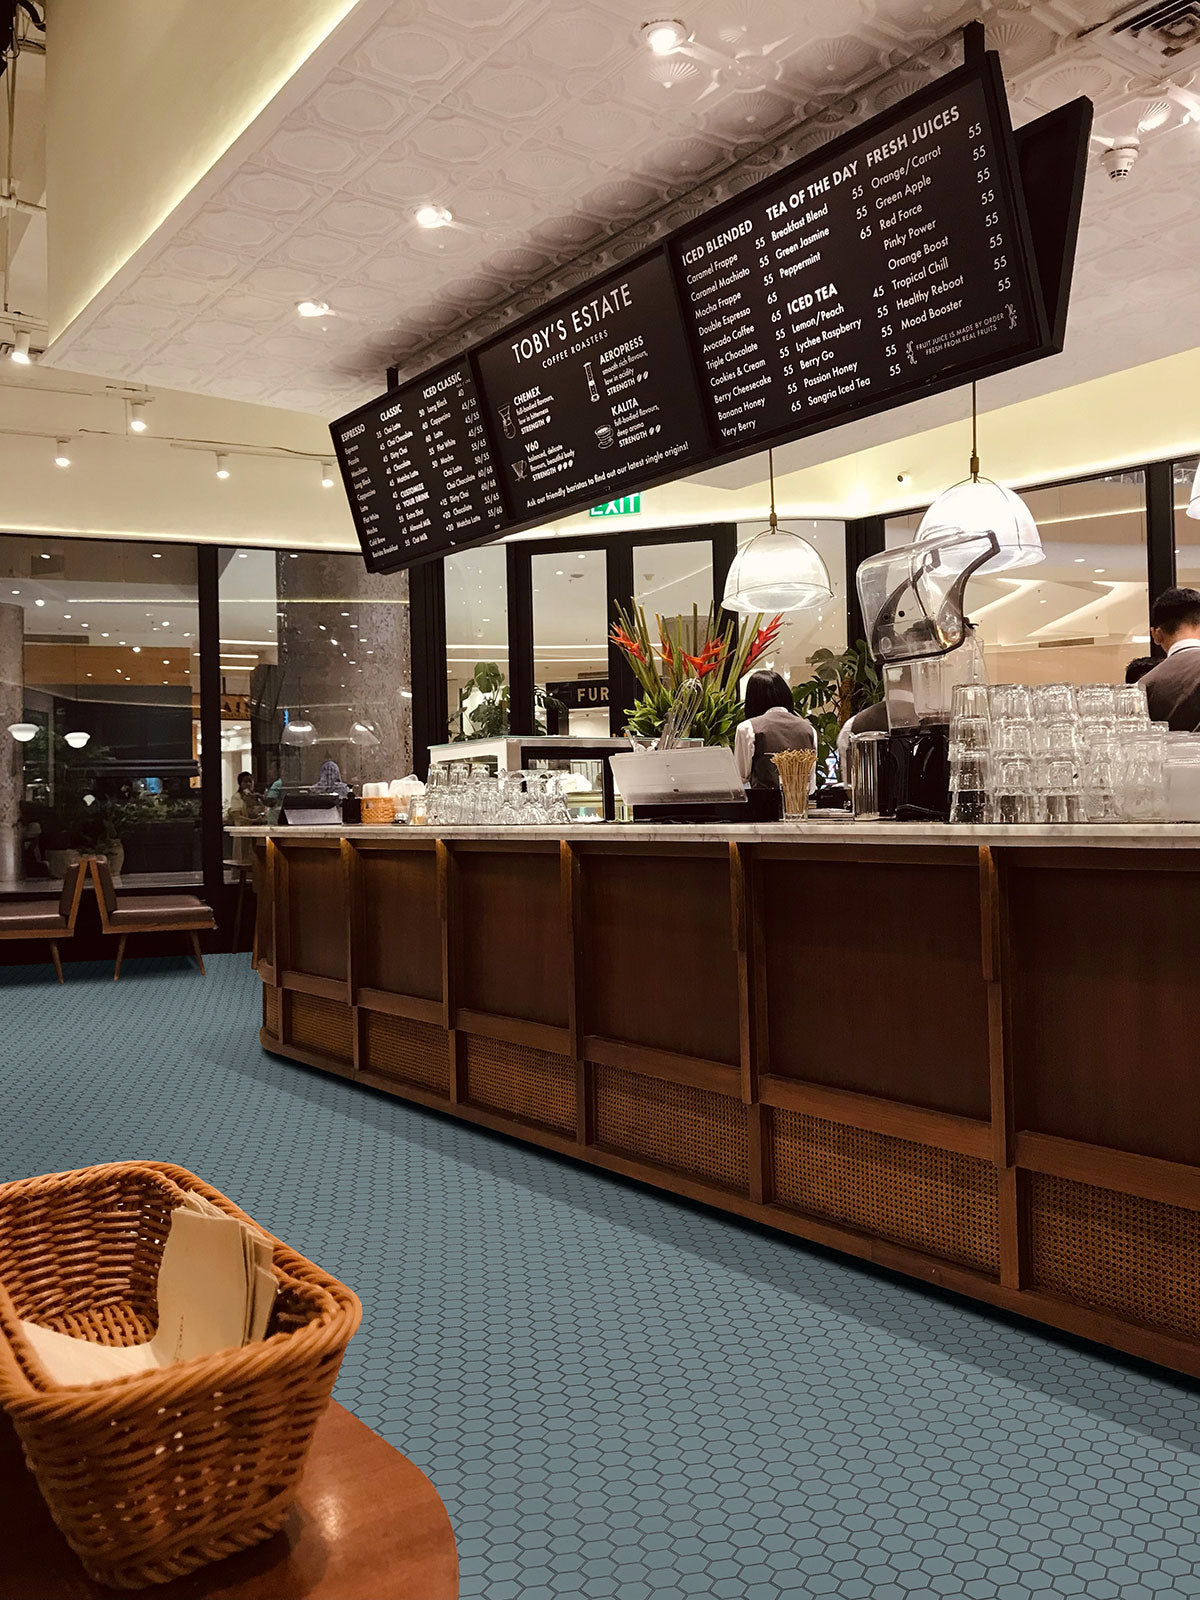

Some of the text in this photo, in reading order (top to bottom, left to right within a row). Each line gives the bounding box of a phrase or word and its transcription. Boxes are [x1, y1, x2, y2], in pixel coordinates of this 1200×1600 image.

[867, 106, 959, 167] FRESH JUICES
[871, 123, 981, 188] Orange/Carrot 55
[766, 160, 857, 220] TEA OF THE DAY
[876, 145, 986, 209] Green Apple 55
[880, 167, 990, 230] Red Force 55
[771, 185, 863, 241] Breakfast Blend 55
[776, 205, 867, 259] Green Jasmine 55
[884, 190, 994, 250] Pinky Power 55
[682, 220, 752, 266] ICED BLENDED
[687, 237, 765, 284] Caramel Frappe 55
[780, 226, 871, 278] Peppermint 65
[888, 212, 998, 269] Orange Boost 55
[891, 234, 1002, 290] Tropical Chill 55
[691, 255, 769, 301] Caramel Machiato 55
[695, 273, 773, 319] Mocha Frappe 55
[787, 283, 838, 315] ICED TEA
[896, 255, 1006, 310] Healthy Reboot 55
[512, 284, 632, 363] TOBY'S ESTATE
[699, 292, 777, 336] Double Espresso 65
[792, 285, 884, 333] Lemon/Peach 45
[901, 277, 1011, 330] Mood Booster 55
[542, 330, 608, 368] COFFEE ROASTERS
[600, 336, 643, 365] AEROPRESS
[703, 310, 781, 353] Avocado Coffee 65
[706, 328, 785, 369] Triple Chocolate 55
[796, 305, 888, 353] Lychee Raspberry 55
[800, 325, 892, 369] Berry Go 55
[916, 340, 931, 350] FRUIT
[933, 334, 948, 345] JUICE
[957, 324, 973, 335] MADE
[984, 313, 1004, 325] ORDER
[926, 345, 943, 355] FRESH
[944, 338, 961, 348] FROM
[977, 324, 997, 336] FRUITS
[423, 386, 437, 399] ICED
[437, 372, 462, 391] CLASSIC
[607, 378, 635, 396] STRENGTH
[710, 372, 736, 386] Cookies
[743, 360, 766, 373] Cream
[780, 346, 789, 358] 55
[714, 364, 793, 404] Berry Cheesecake 55
[804, 344, 896, 387] Passion Honey 55
[808, 364, 901, 405] Sangria Iced Tea 55
[380, 404, 402, 421] CLASSIC
[514, 386, 541, 406] CHEMEX
[611, 398, 639, 416] KALITA
[718, 383, 797, 420] Banana Honey 55
[341, 424, 365, 442] ESPRESSO
[521, 419, 545, 434] STRENGTH
[619, 430, 647, 447] STRENGTH
[629, 422, 644, 432] aroma
[721, 400, 801, 437] Very Berry 65
[525, 440, 539, 452] V60
[527, 498, 536, 507] Ask
[546, 488, 565, 500] friendly
[566, 481, 587, 493] baristas
[594, 472, 606, 482] find
[606, 469, 616, 478] out
[627, 459, 644, 470] latest
[645, 451, 663, 464] single
[664, 441, 688, 457] origins!
[532, 467, 556, 481] STRENGTH
[577, 687, 609, 702] FUR
